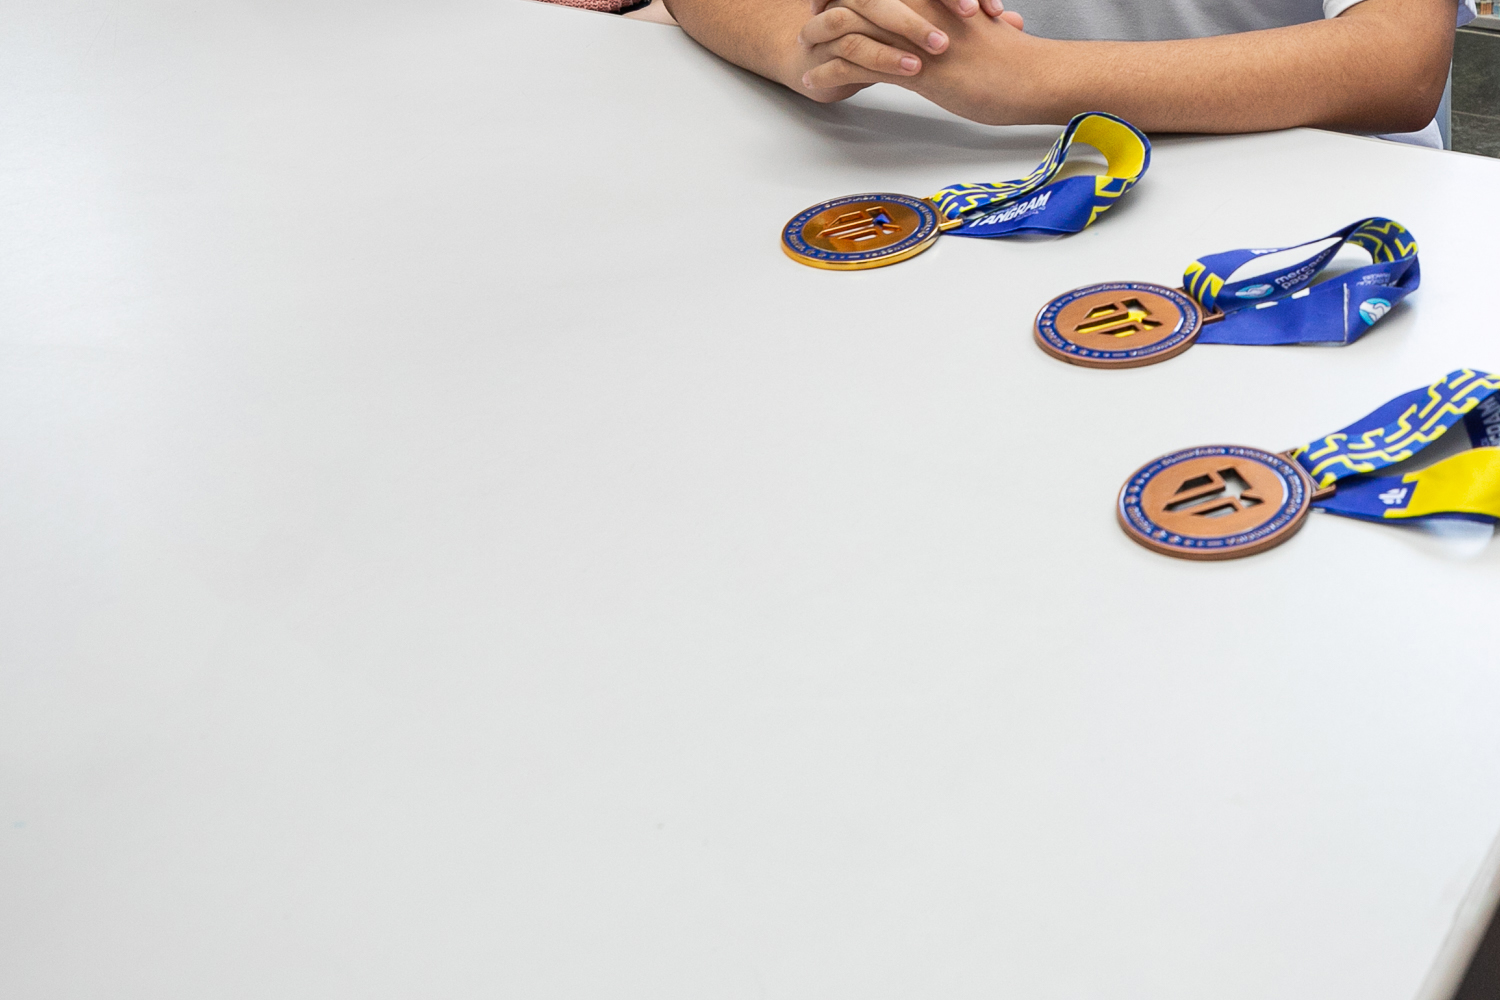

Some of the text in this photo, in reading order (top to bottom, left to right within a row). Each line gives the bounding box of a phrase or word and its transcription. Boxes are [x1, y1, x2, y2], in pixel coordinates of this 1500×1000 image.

[969, 191, 1052, 228] TANGRAM
[1274, 249, 1332, 285] mercado
[1281, 268, 1315, 290] pago
